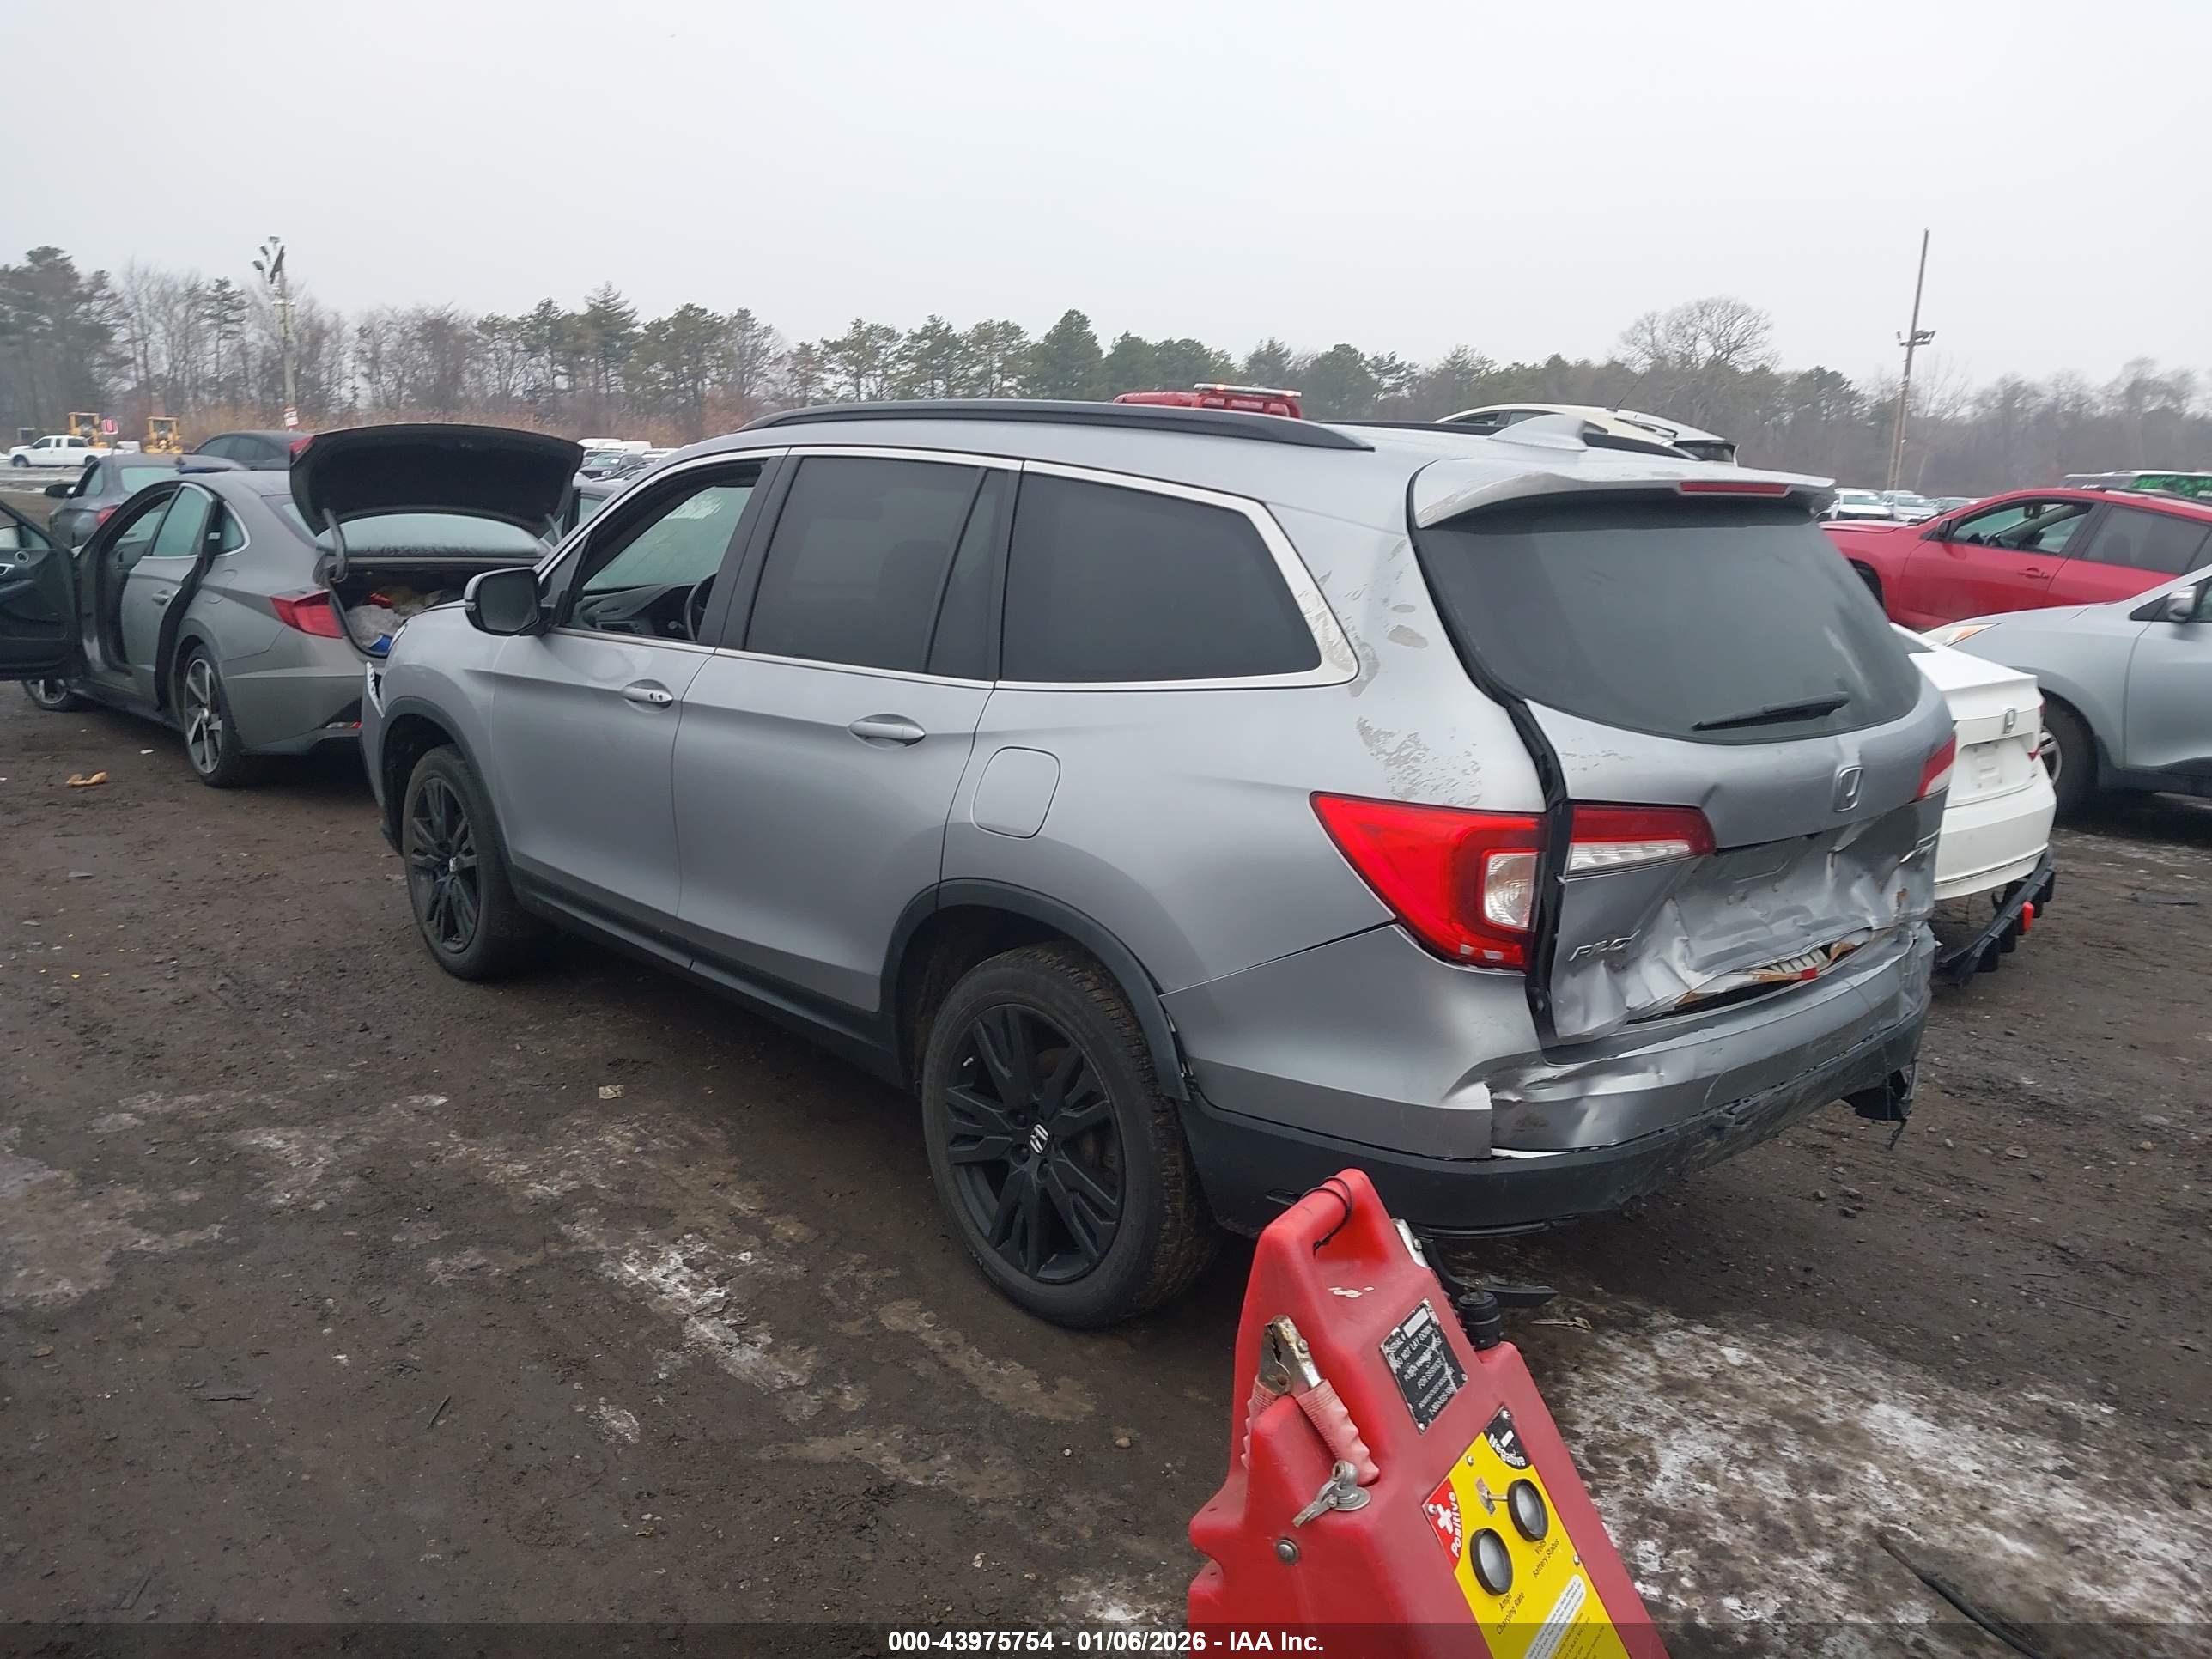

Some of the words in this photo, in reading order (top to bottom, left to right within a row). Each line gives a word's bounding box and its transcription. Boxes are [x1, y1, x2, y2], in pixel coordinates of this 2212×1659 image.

[1401, 1346, 1413, 1361] NOT
[1409, 1337, 1420, 1351] LAY
[1419, 1323, 1434, 1341] DOWN
[1488, 1432, 1527, 1467] Negative
[1449, 1492, 1463, 1558] Positive
[1532, 1555, 1549, 1578] Battery
[1546, 1538, 1560, 1559] Status
[1534, 1540, 1547, 1555] Volts
[1497, 1606, 1517, 1635] Charging
[1513, 1591, 1526, 1608] Rate
[1498, 1592, 1512, 1611] Amps
